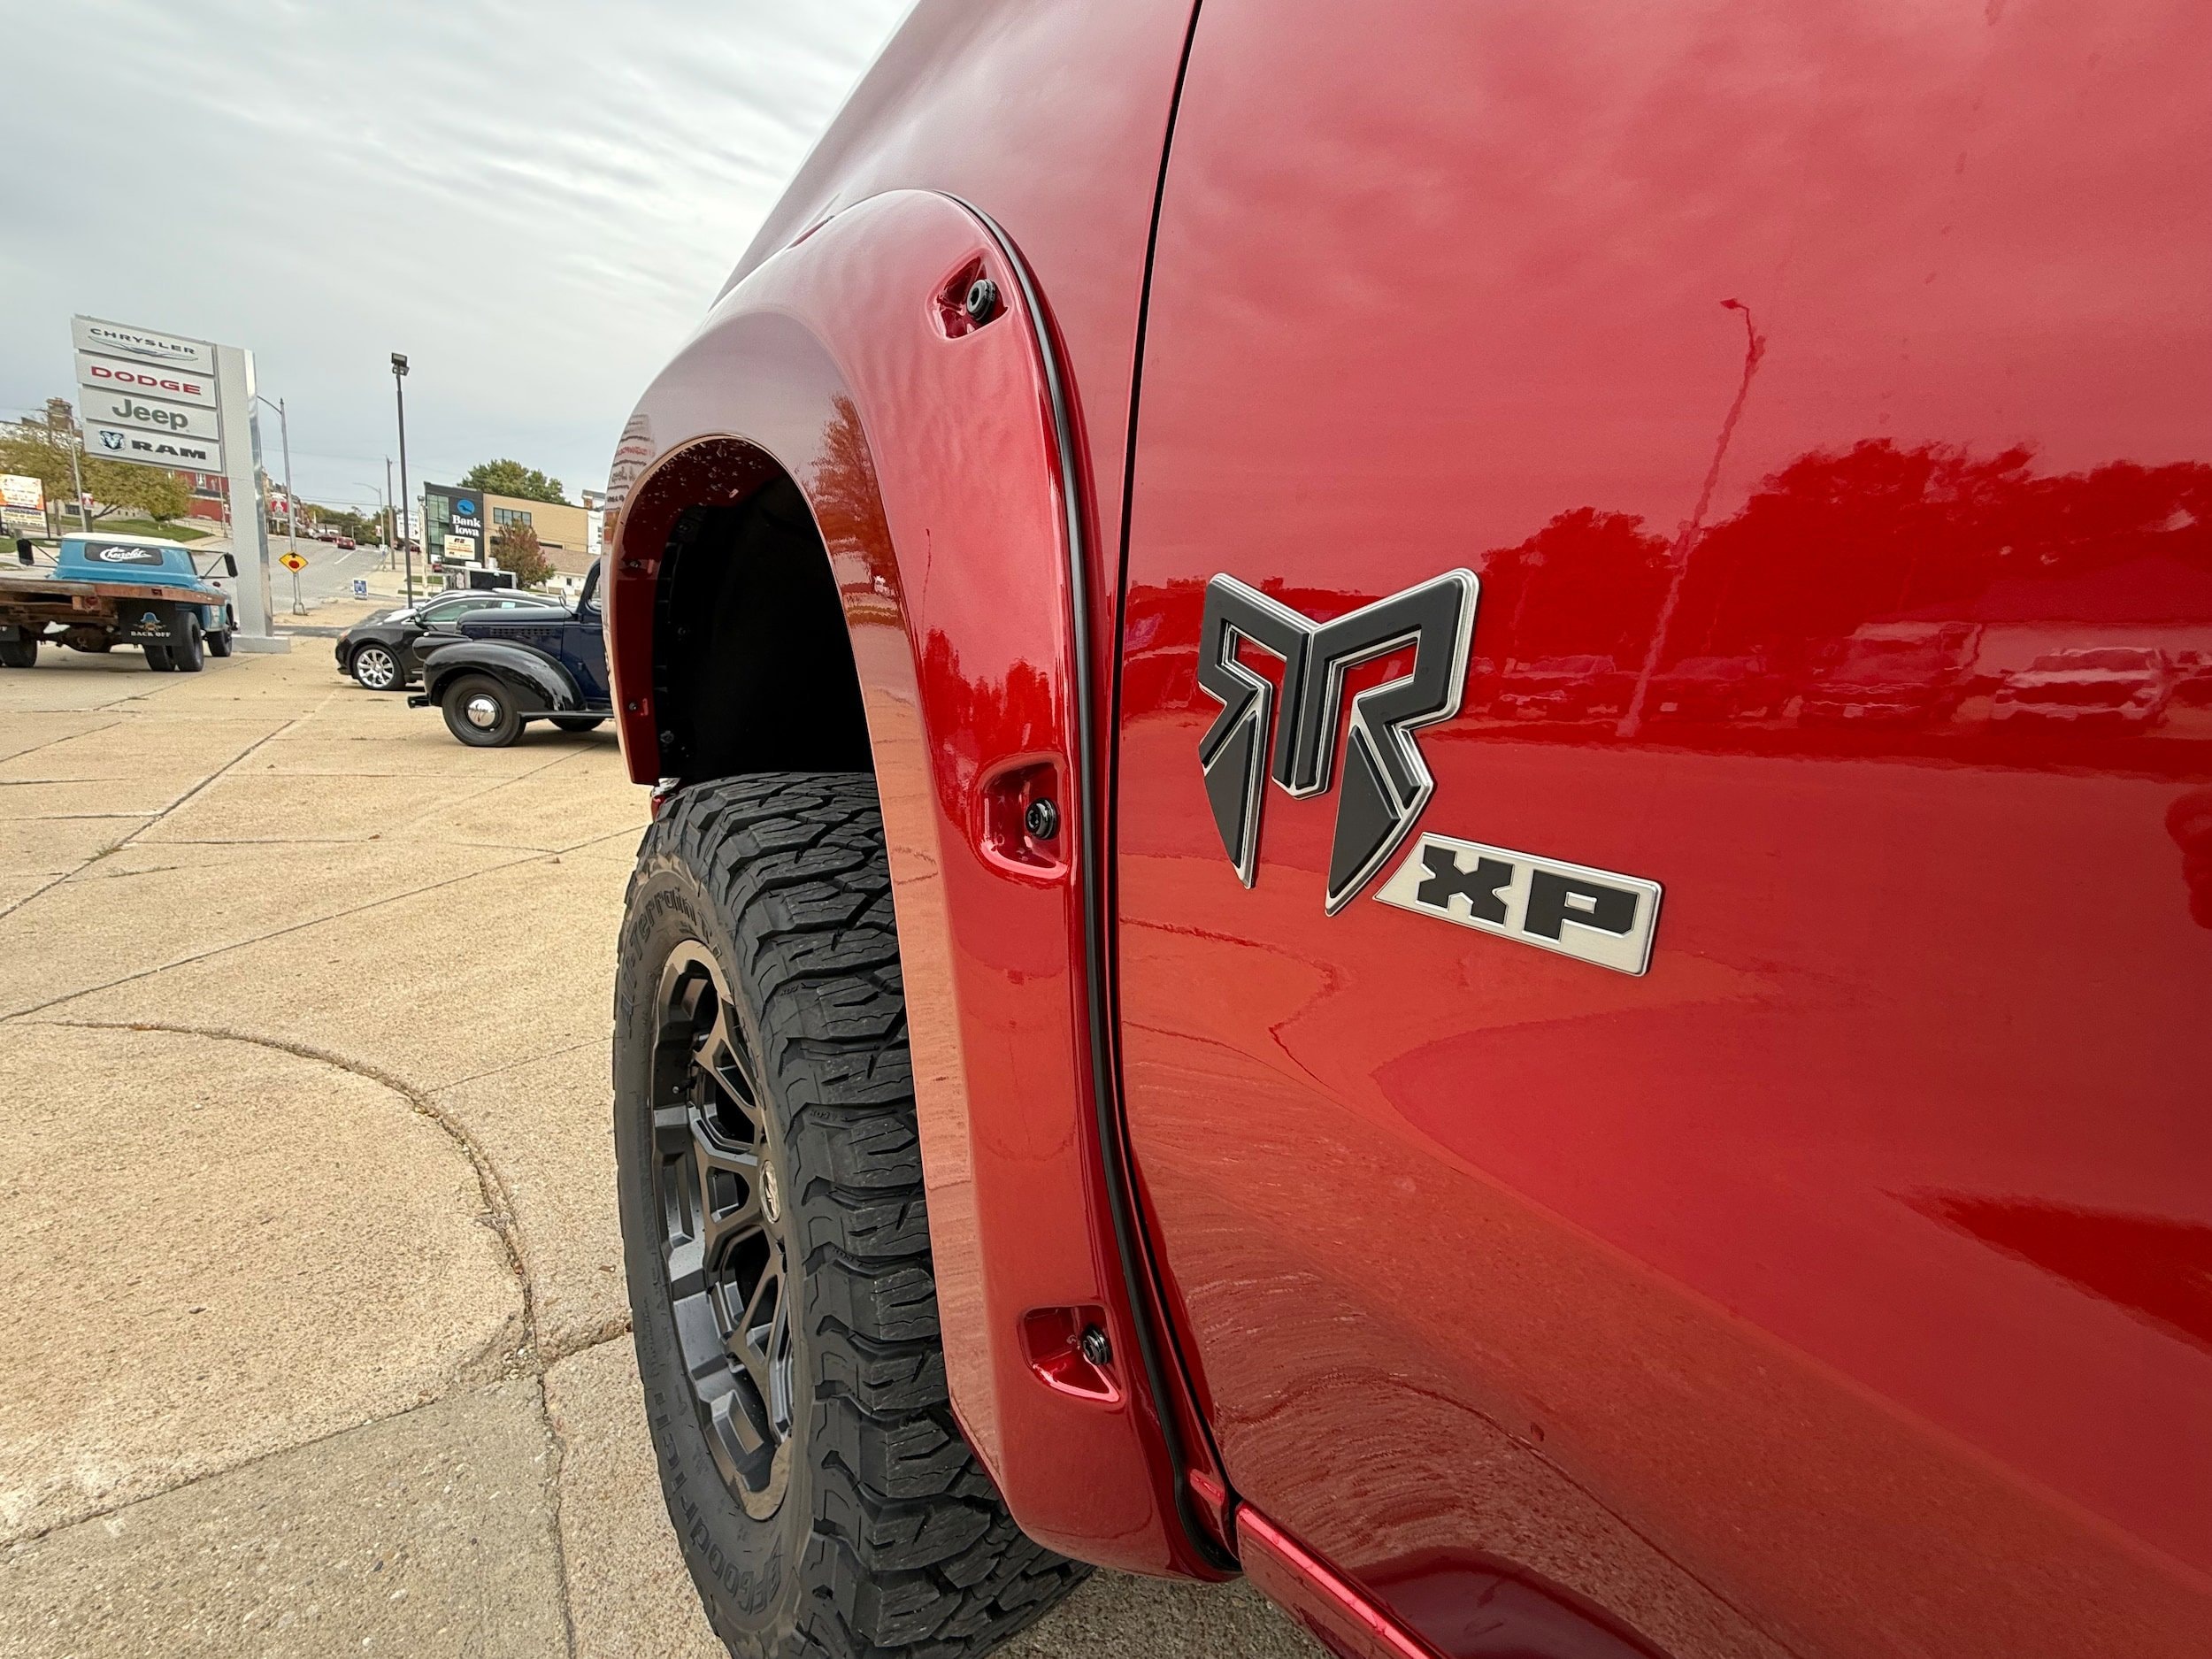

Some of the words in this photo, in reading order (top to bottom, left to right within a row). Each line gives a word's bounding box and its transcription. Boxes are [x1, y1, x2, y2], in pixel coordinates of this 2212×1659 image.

[89, 327, 196, 354] CHRYSLER
[90, 365, 202, 396] DODGE
[111, 398, 188, 430] Jeep
[131, 439, 206, 460] RAM
[452, 514, 481, 528] Bank
[455, 525, 480, 537] Iowa
[1417, 844, 1639, 941] XP
